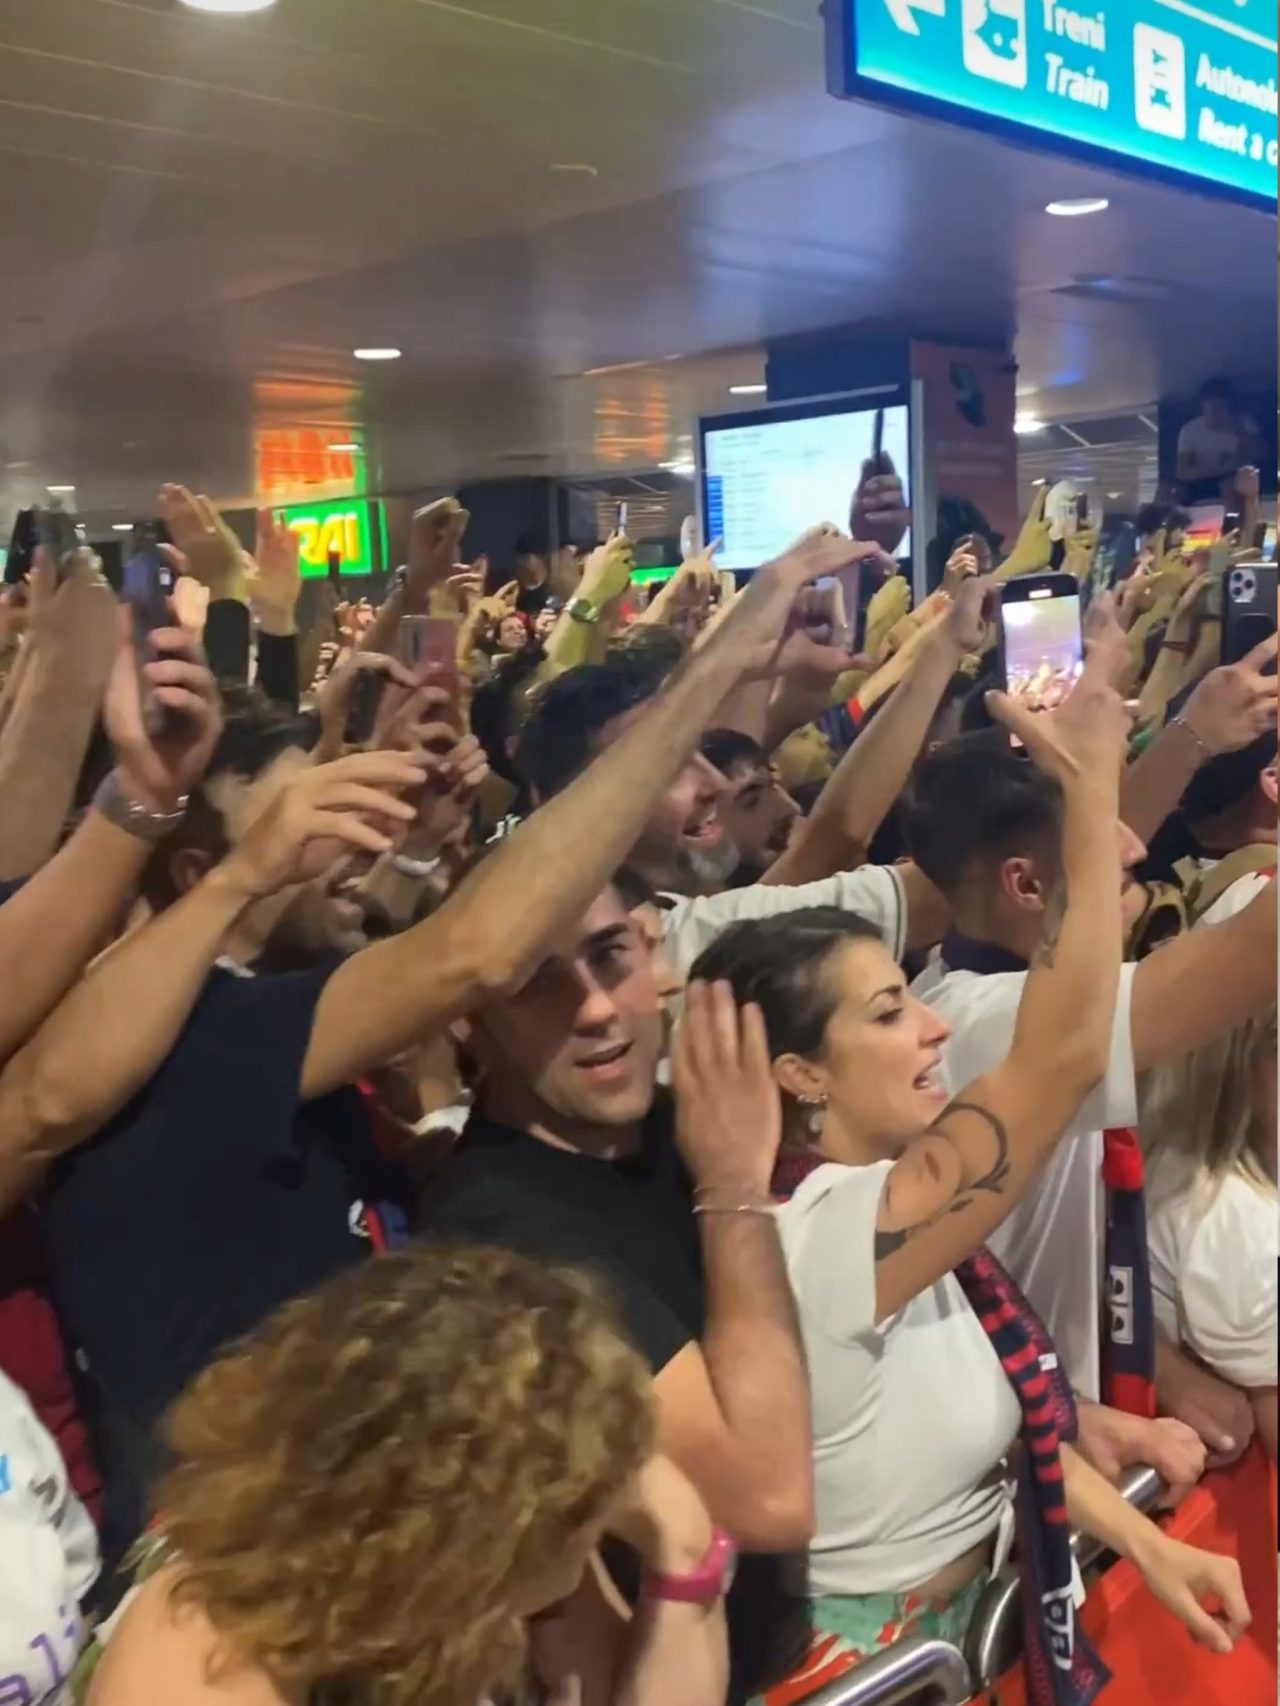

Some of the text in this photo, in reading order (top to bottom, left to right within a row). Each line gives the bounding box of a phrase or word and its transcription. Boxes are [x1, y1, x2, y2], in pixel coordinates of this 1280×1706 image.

[1045, 52, 1109, 110] Train
[1198, 106, 1248, 156] Rent
[1250, 133, 1263, 160] a
